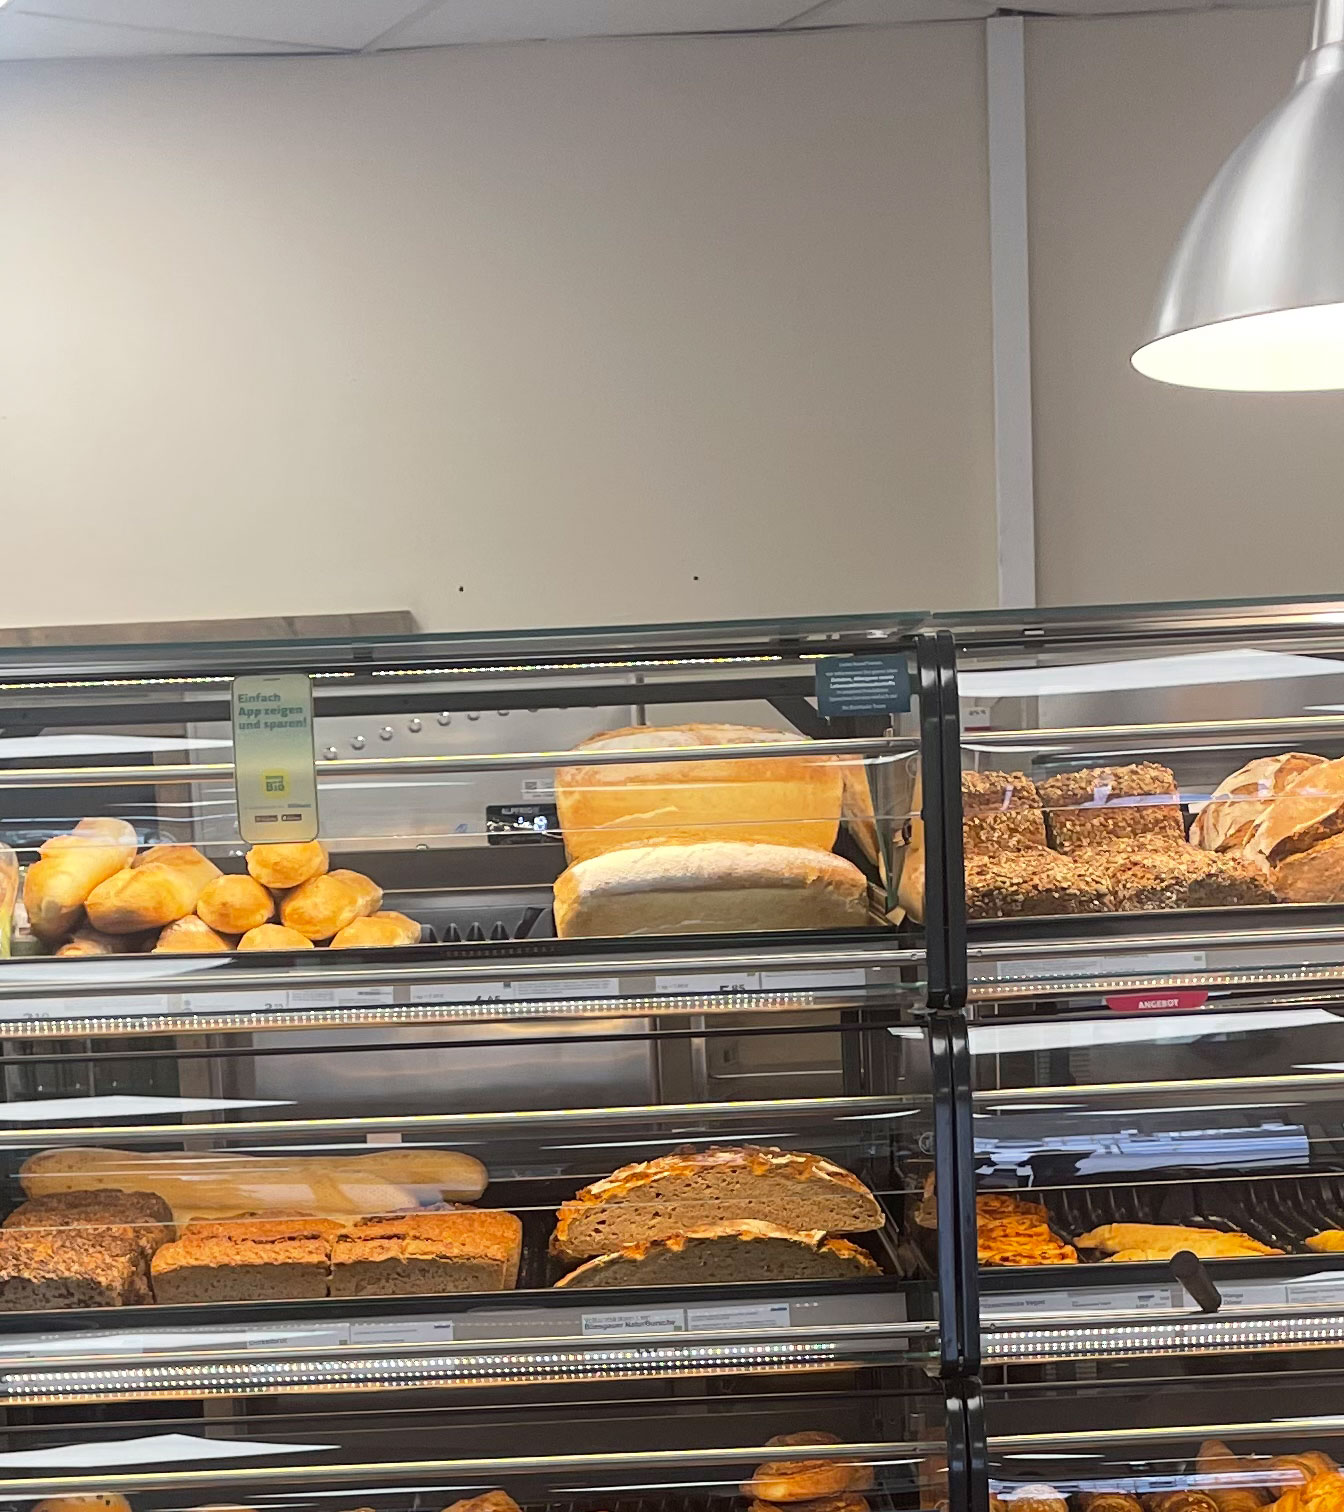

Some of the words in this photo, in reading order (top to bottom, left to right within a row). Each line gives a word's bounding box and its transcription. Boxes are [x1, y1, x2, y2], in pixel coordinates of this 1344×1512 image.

[238, 693, 281, 703] Einfach
[238, 707, 261, 717] App
[264, 706, 303, 717] zeigen
[239, 720, 260, 730] und
